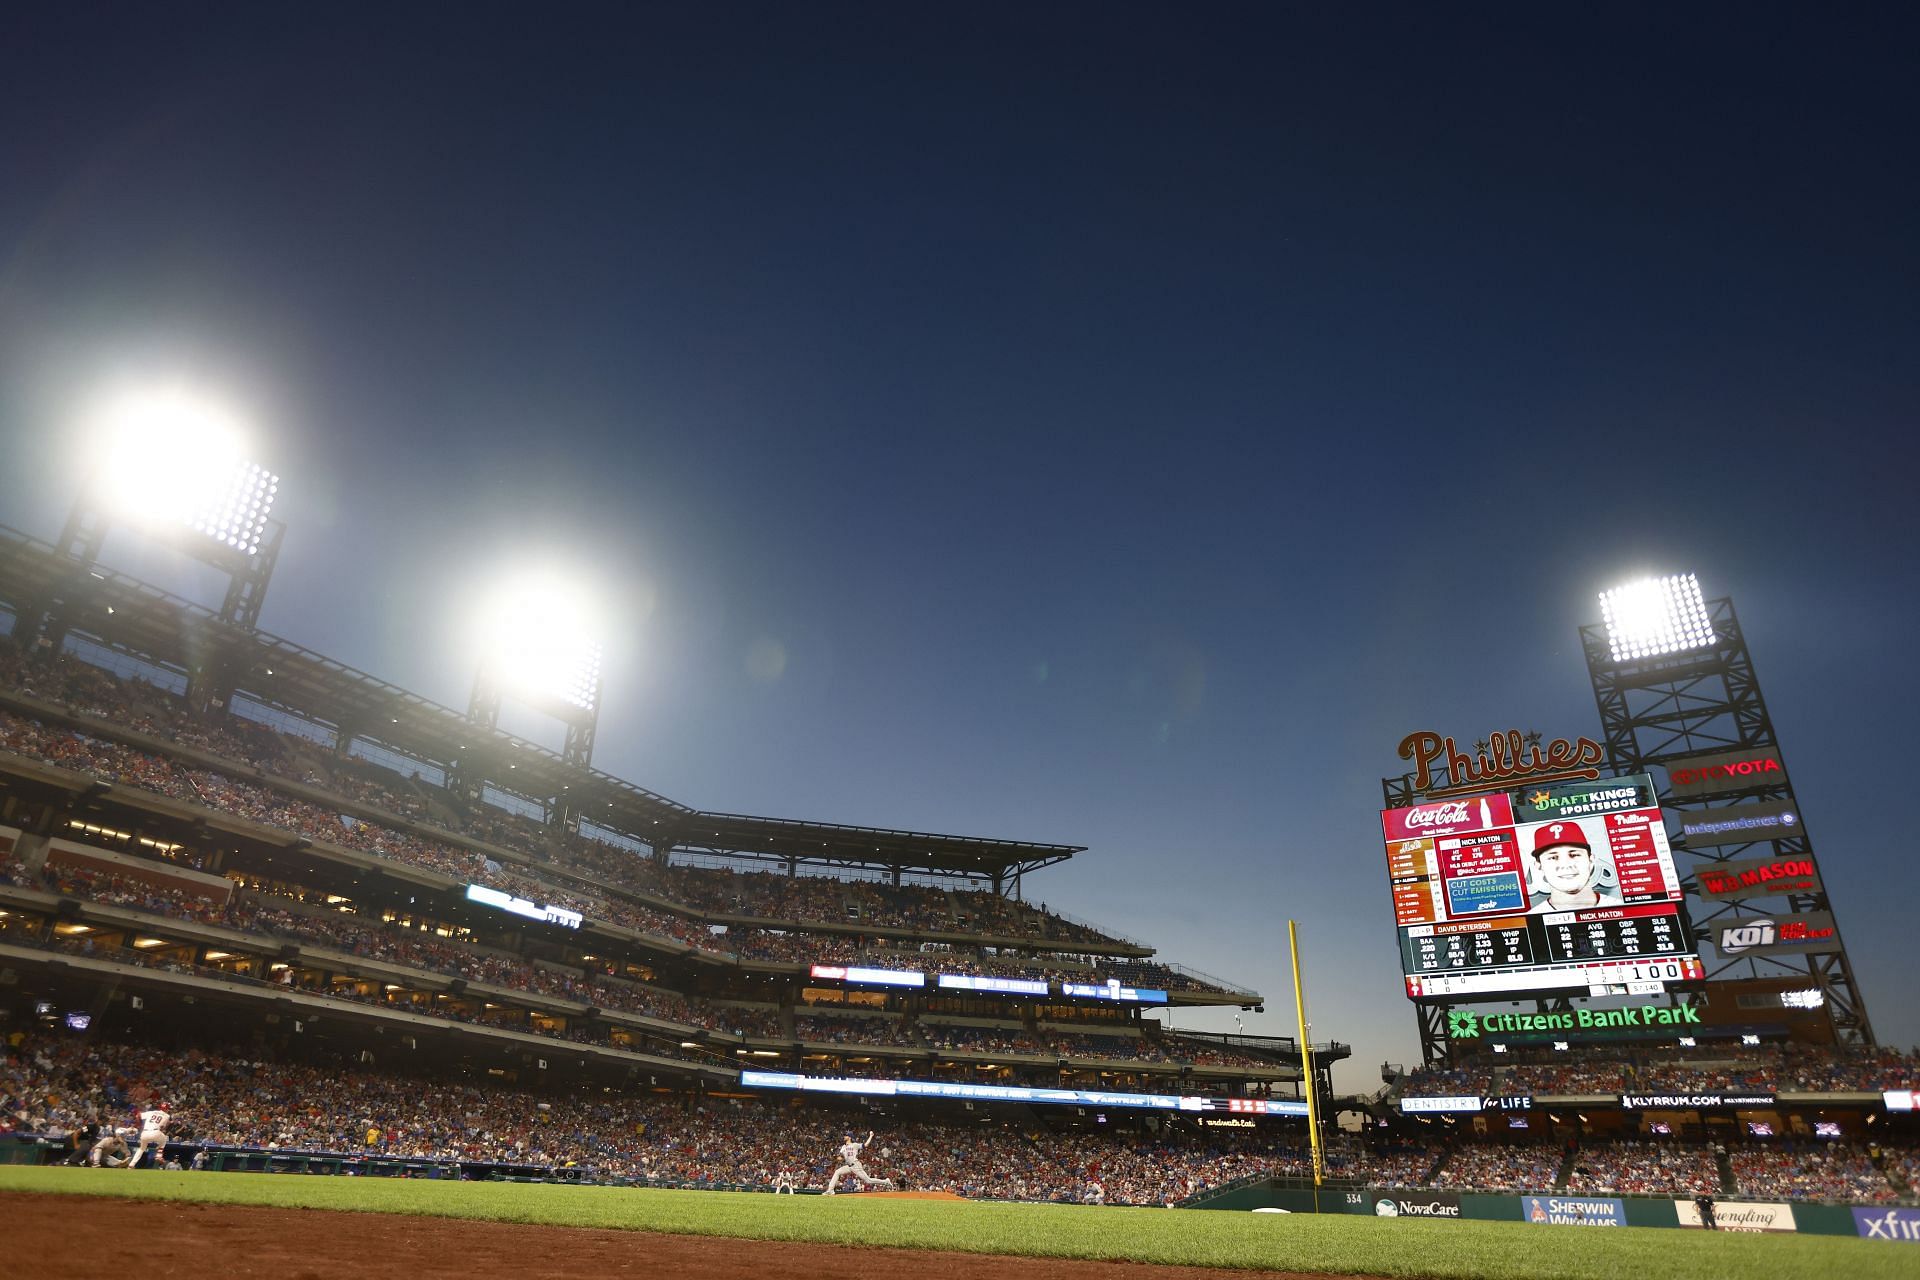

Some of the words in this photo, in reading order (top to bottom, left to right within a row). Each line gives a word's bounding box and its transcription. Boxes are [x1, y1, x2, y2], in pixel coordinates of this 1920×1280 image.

[1398, 729, 1603, 792] Phillies
[1701, 758, 1780, 781] TOYOTA
[1535, 787, 1636, 811] DRAFTKINGS
[1560, 798, 1637, 815] SPORTSBOOK
[1684, 816, 1779, 836] Independence
[1461, 837, 1477, 846] NICK
[1478, 835, 1500, 844] MATON
[1450, 881, 1467, 889] CUT
[1470, 878, 1497, 887] COSTS
[1452, 888, 1468, 897] CUT
[1471, 883, 1518, 895] EMISSIONS
[1580, 912, 1597, 920] NICK
[1598, 910, 1623, 919] MATON
[1438, 925, 1457, 933] DAVID
[1458, 922, 1491, 931] PETERSON
[1502, 930, 1520, 938] WHIP
[1633, 967, 1642, 980] 1
[1649, 966, 1660, 979] 0
[1666, 964, 1677, 978] 0
[1688, 969, 1696, 978] 4
[1483, 1011, 1574, 1032] Citizens
[1577, 1006, 1638, 1028] Bank
[1642, 1003, 1701, 1025] Park
[1100, 1095, 1144, 1105] AMTRAK
[1404, 1098, 1476, 1110] DENTISTRY
[1483, 1097, 1498, 1110] for
[1501, 1097, 1531, 1109] LIFE
[1632, 1095, 1722, 1107] KLYRRUM.COM
[1346, 1193, 1362, 1204] 334
[1399, 1200, 1458, 1217] NovaCare
[1549, 1199, 1614, 1215] SHERWIN
